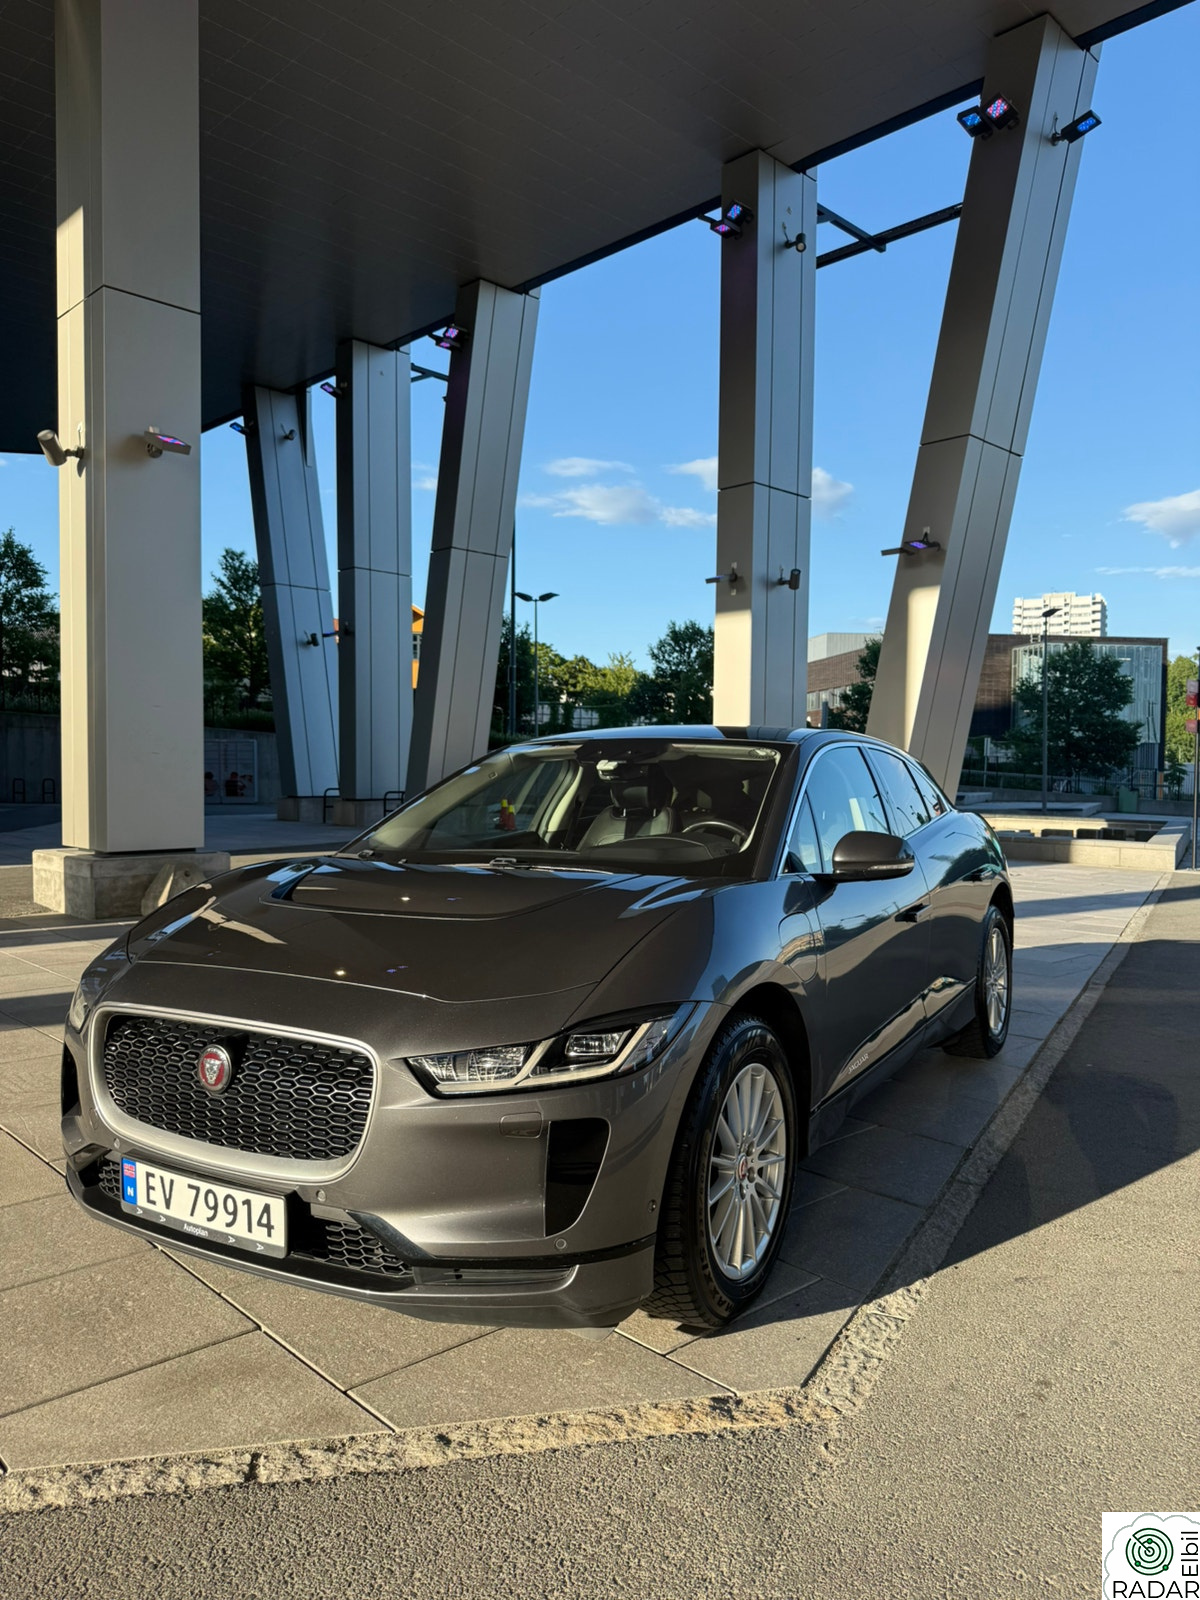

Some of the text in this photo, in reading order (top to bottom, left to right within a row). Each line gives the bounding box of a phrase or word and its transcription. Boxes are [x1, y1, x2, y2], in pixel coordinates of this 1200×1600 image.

[127, 1186, 134, 1197] N
[145, 1171, 275, 1238] EV 79914
[183, 1223, 209, 1237] Autoplan
